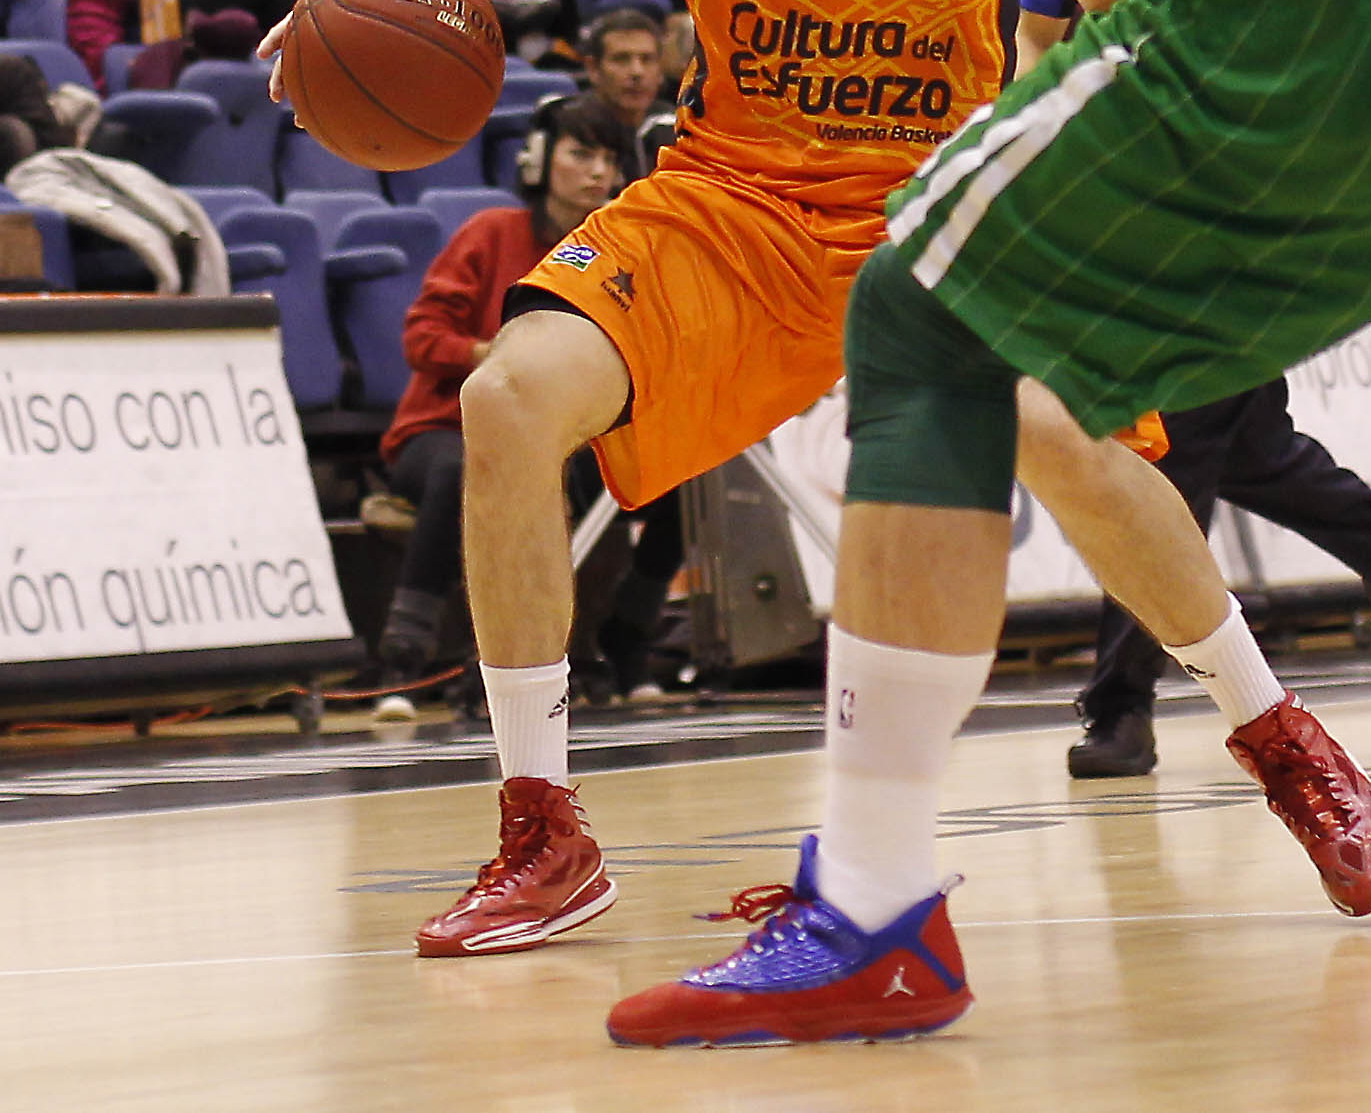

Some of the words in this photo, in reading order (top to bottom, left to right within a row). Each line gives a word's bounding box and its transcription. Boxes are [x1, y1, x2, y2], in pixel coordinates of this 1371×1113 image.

[730, 2, 907, 59] Cultura
[912, 34, 956, 63] del
[730, 52, 952, 119] Esfuerzo
[816, 123, 887, 142] Valencia
[115, 389, 220, 451] con
[227, 363, 286, 447] la
[102, 539, 325, 653] química
